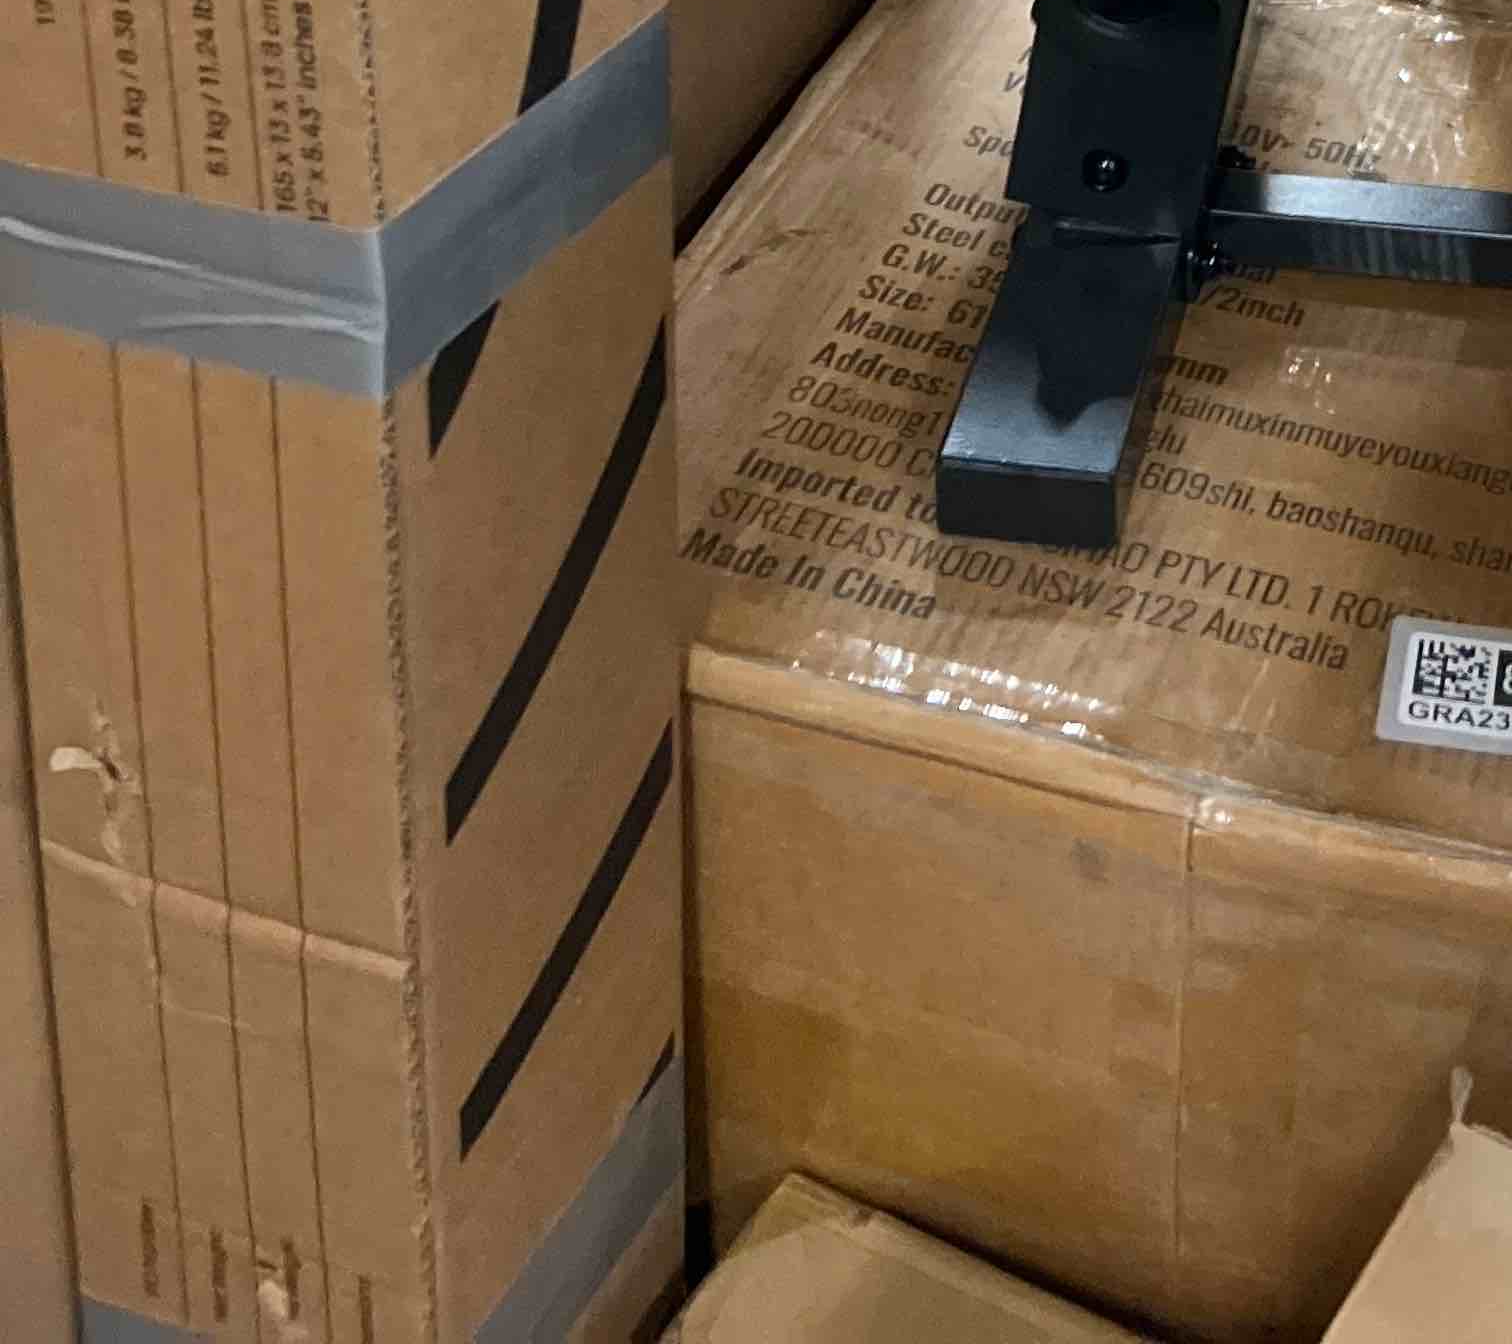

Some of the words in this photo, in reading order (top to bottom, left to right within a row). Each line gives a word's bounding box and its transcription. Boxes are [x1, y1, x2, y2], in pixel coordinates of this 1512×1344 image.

[288, 0, 318, 91] inches
[117, 84, 149, 119] kg
[201, 107, 233, 140] kg
[901, 210, 981, 254] Steel
[855, 271, 936, 317] Size:
[808, 337, 957, 402] Address:
[761, 405, 904, 473] 200000
[732, 444, 901, 522] Imported
[1152, 547, 1224, 594] PTY
[679, 522, 783, 582] Made
[830, 563, 940, 624] China
[708, 485, 1014, 587] STREETEASTWOOD
[1018, 562, 1106, 610] NSW
[1103, 584, 1199, 634] 2122
[1200, 605, 1350, 673] Australia
